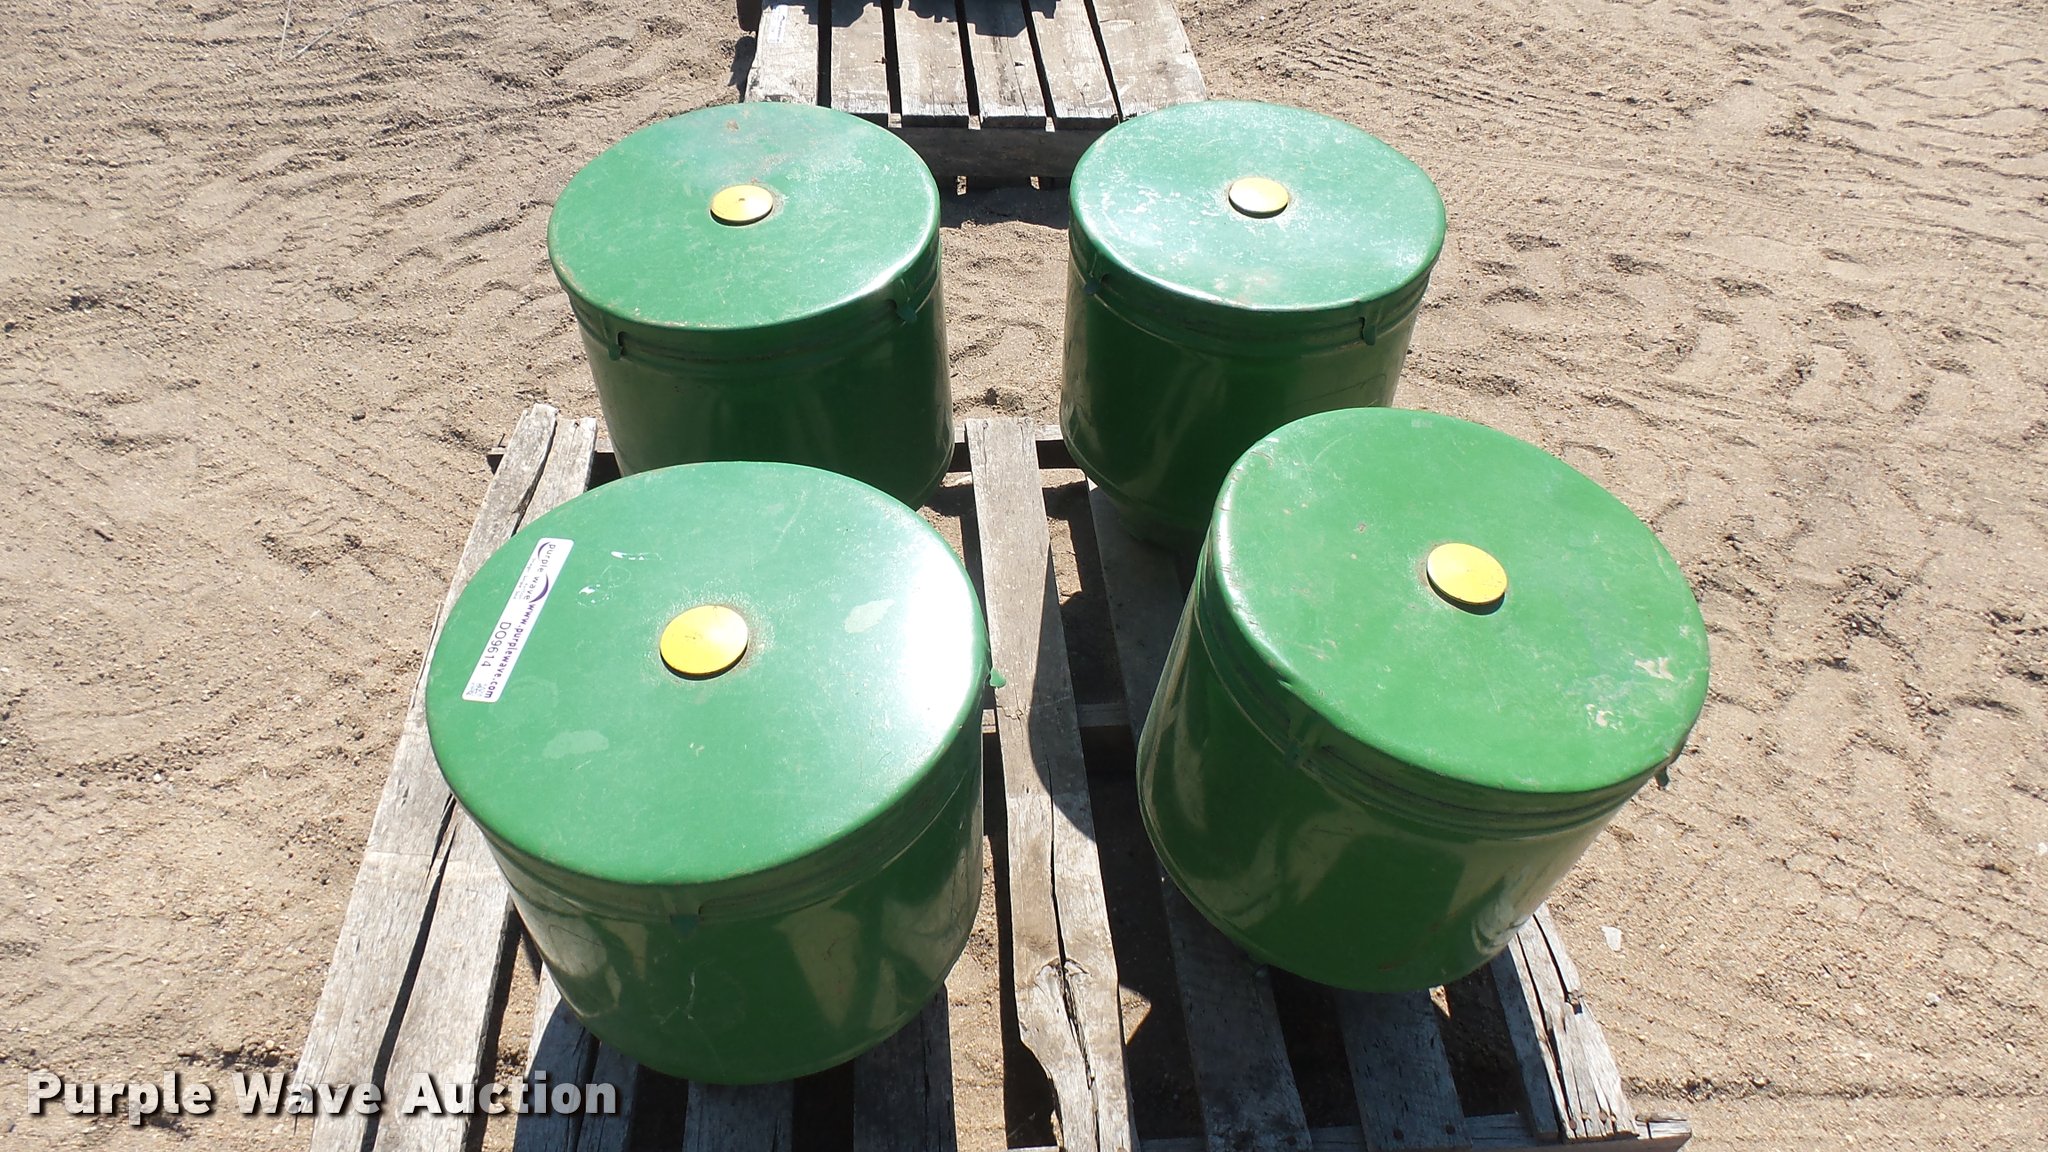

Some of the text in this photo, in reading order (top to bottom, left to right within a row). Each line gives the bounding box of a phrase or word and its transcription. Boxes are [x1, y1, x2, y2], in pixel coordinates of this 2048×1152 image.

[536, 543, 556, 573] purple
[523, 576, 539, 601] wave
[484, 603, 536, 699] www.purplewave.com
